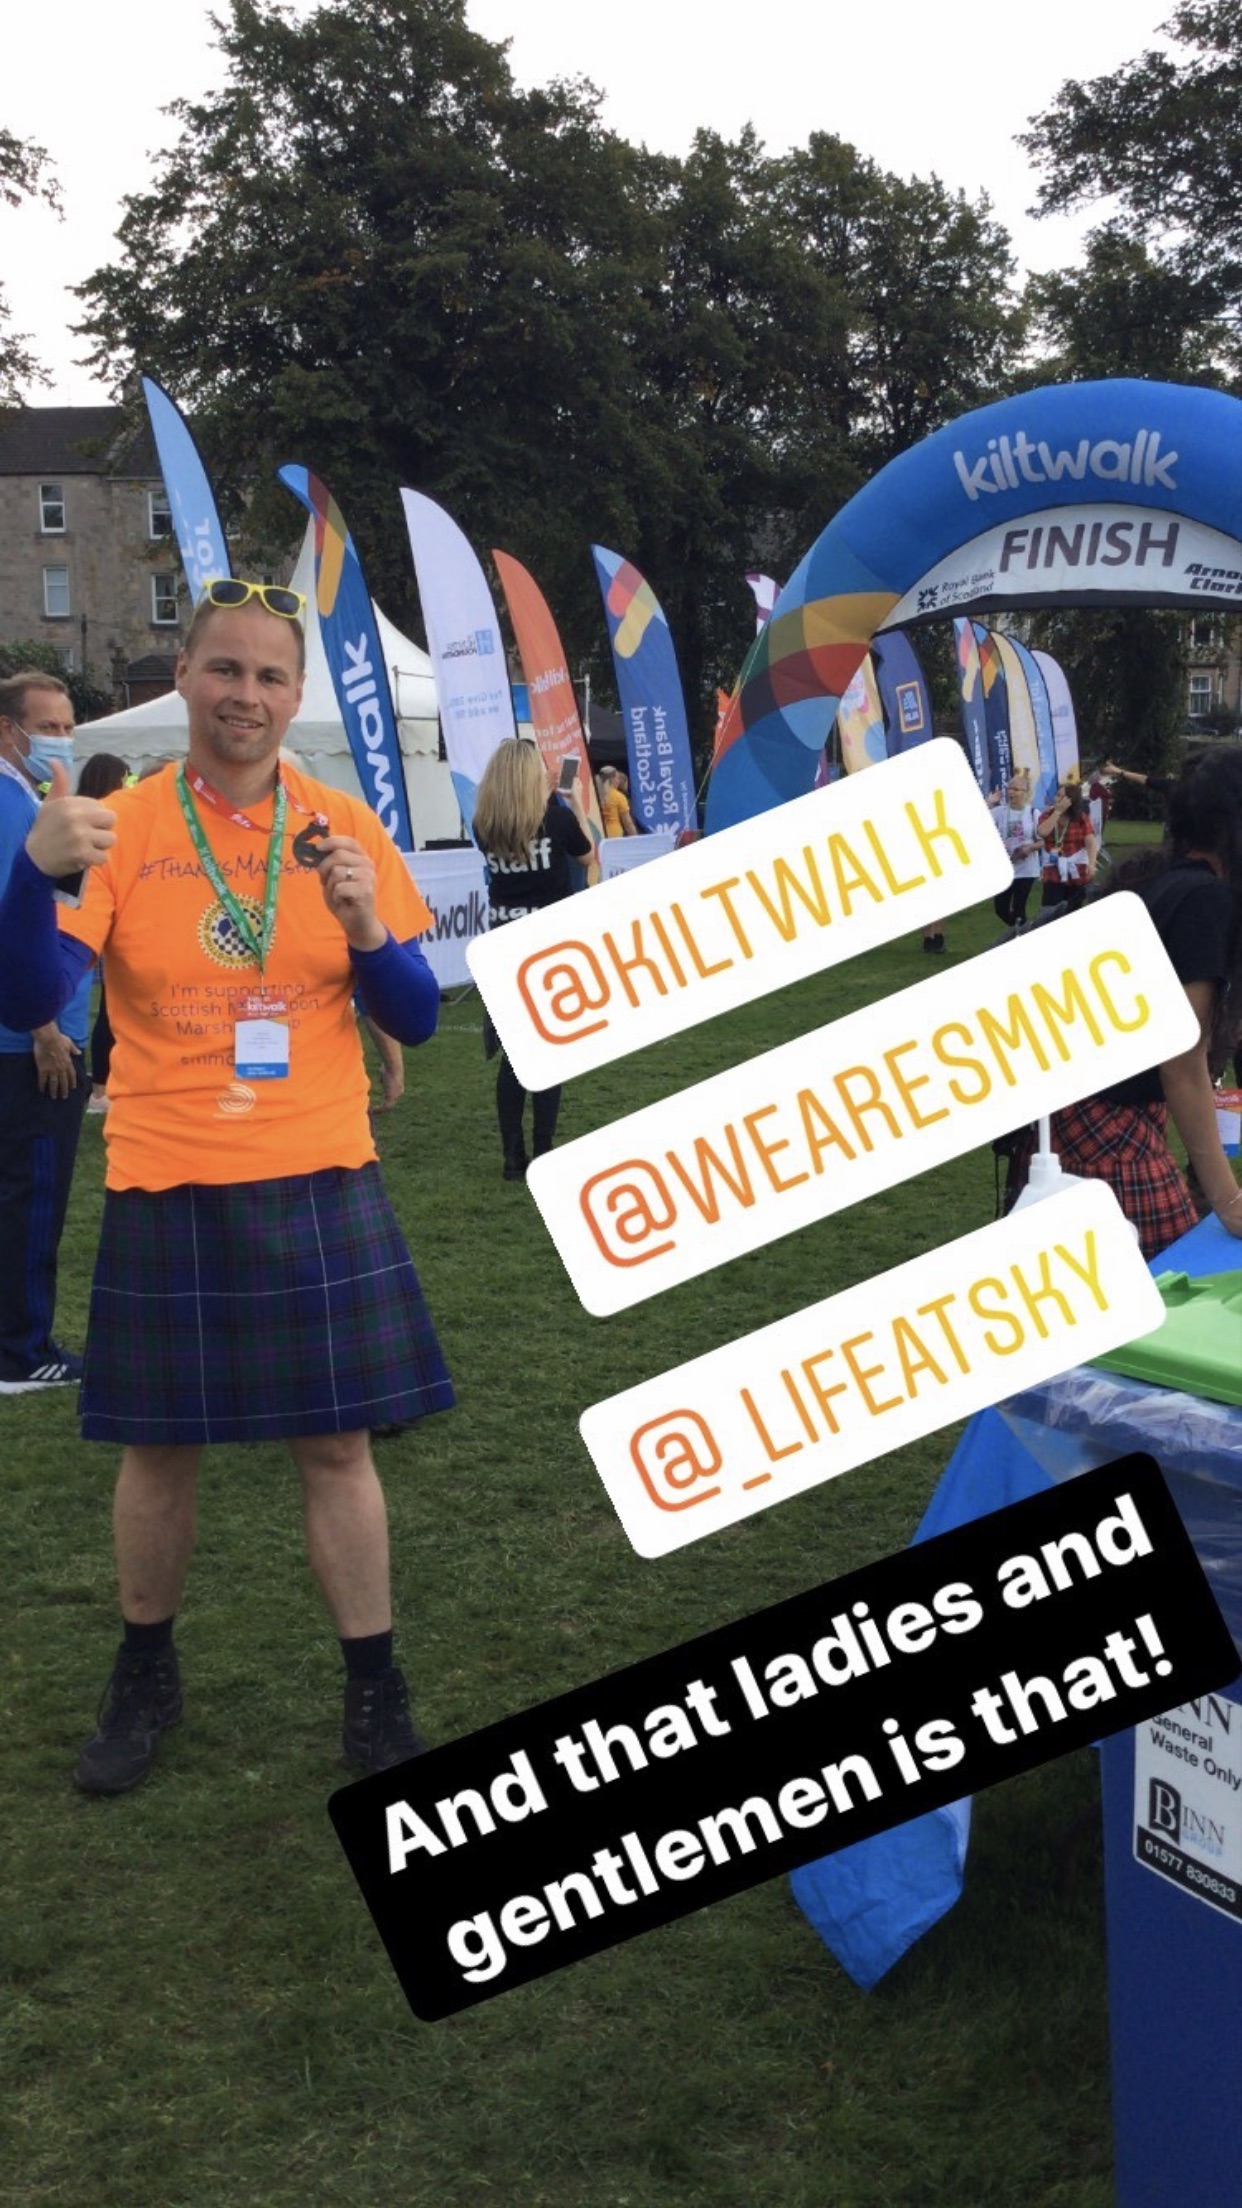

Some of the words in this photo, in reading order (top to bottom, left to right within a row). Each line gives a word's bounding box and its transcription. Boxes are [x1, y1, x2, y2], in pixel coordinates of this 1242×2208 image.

[953, 429, 1178, 500] kiltwalk
[999, 521, 1180, 573] FINISH
[941, 576, 969, 592] Royal
[971, 569, 995, 584] Bank
[1184, 563, 1242, 580] Arno
[940, 595, 951, 605] of
[952, 582, 994, 601] Scotland
[488, 837, 552, 874] staff
[419, 891, 486, 943] twalk
[170, 983, 198, 998] I'm
[205, 982, 305, 999] supporting
[150, 1001, 222, 1018] Scottish
[176, 1020, 233, 1036] Marsh
[1152, 1716, 1213, 1752] General
[1150, 1727, 1199, 1767] Waste
[1204, 1757, 1242, 1791] Only
[1145, 1838, 1184, 1872] 01577
[1186, 1862, 1237, 1903] 830833
